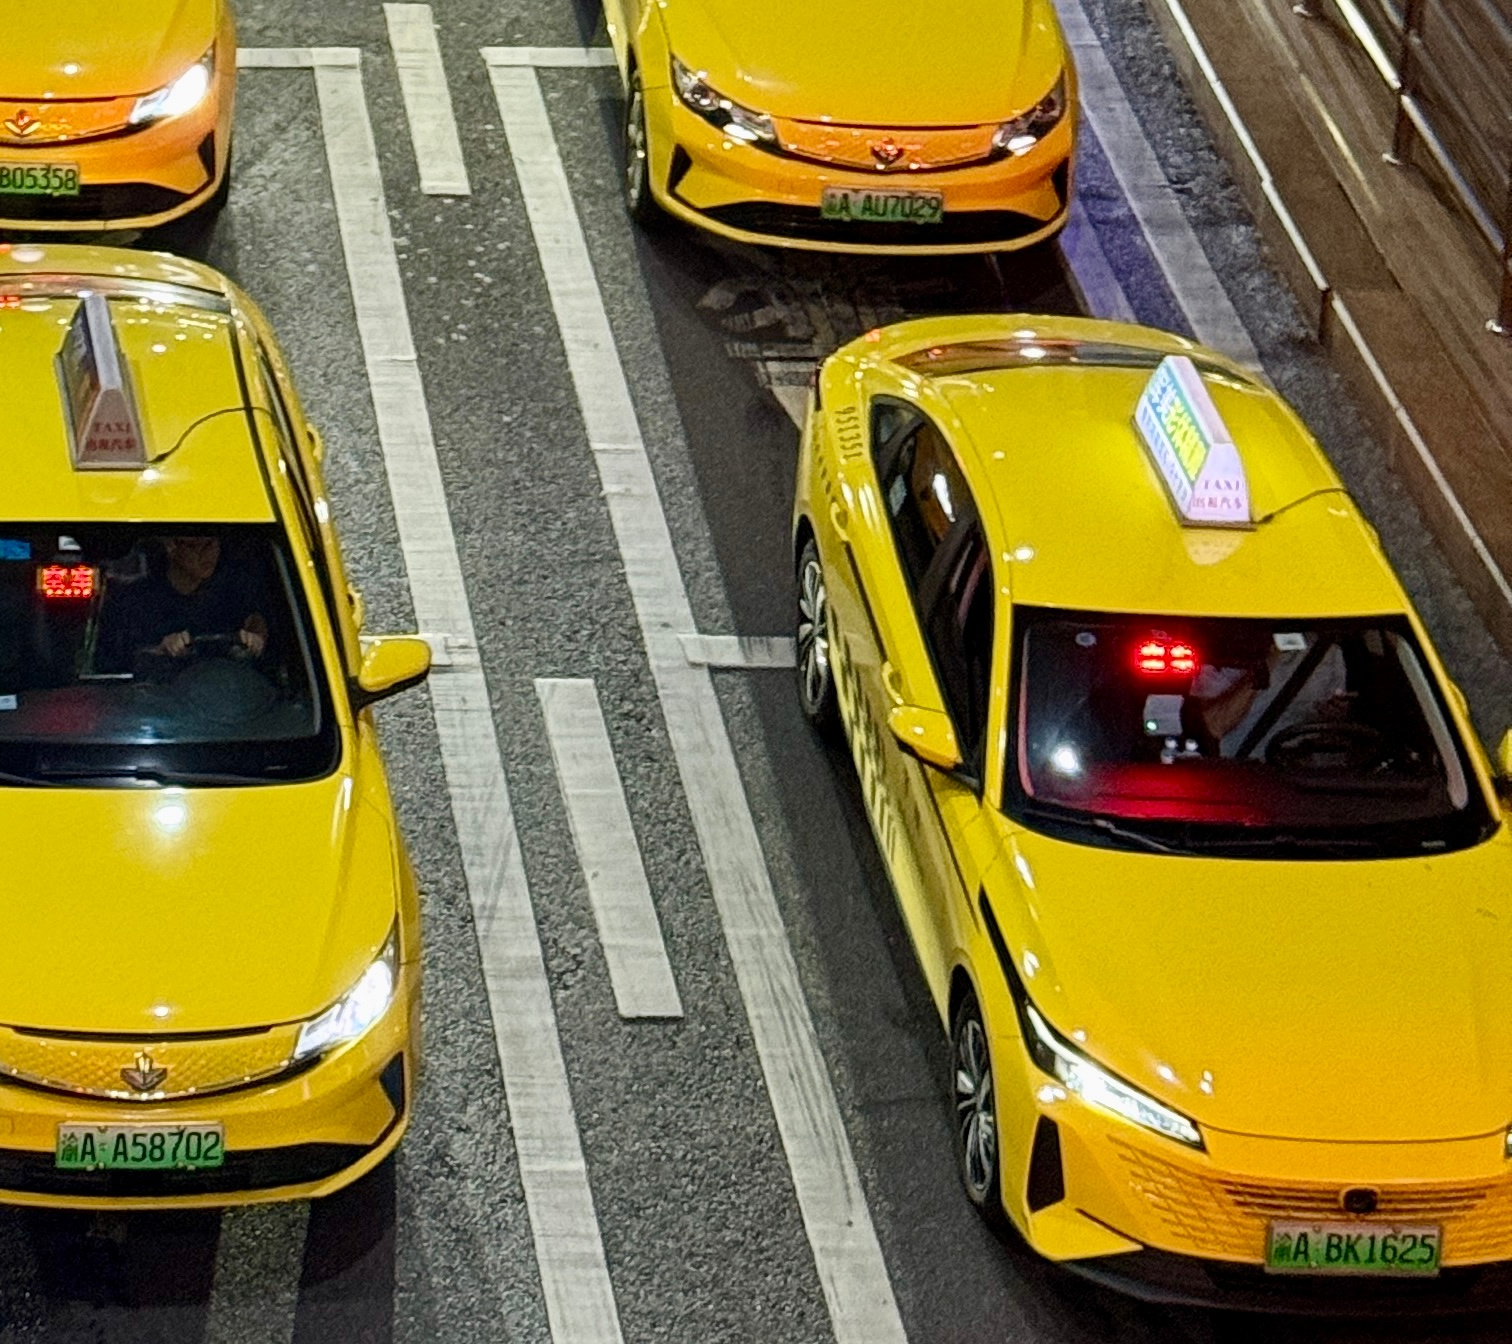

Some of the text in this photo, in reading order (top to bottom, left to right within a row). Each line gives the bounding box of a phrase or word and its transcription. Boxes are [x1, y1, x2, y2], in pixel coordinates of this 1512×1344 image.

[861, 194, 940, 218] AU7029
[94, 422, 133, 433] TAXI
[834, 406, 864, 461] 951351
[1204, 480, 1245, 491] TAXI
[61, 1131, 220, 1163] 渝A A58702
[1325, 1232, 1436, 1263] BK1625
